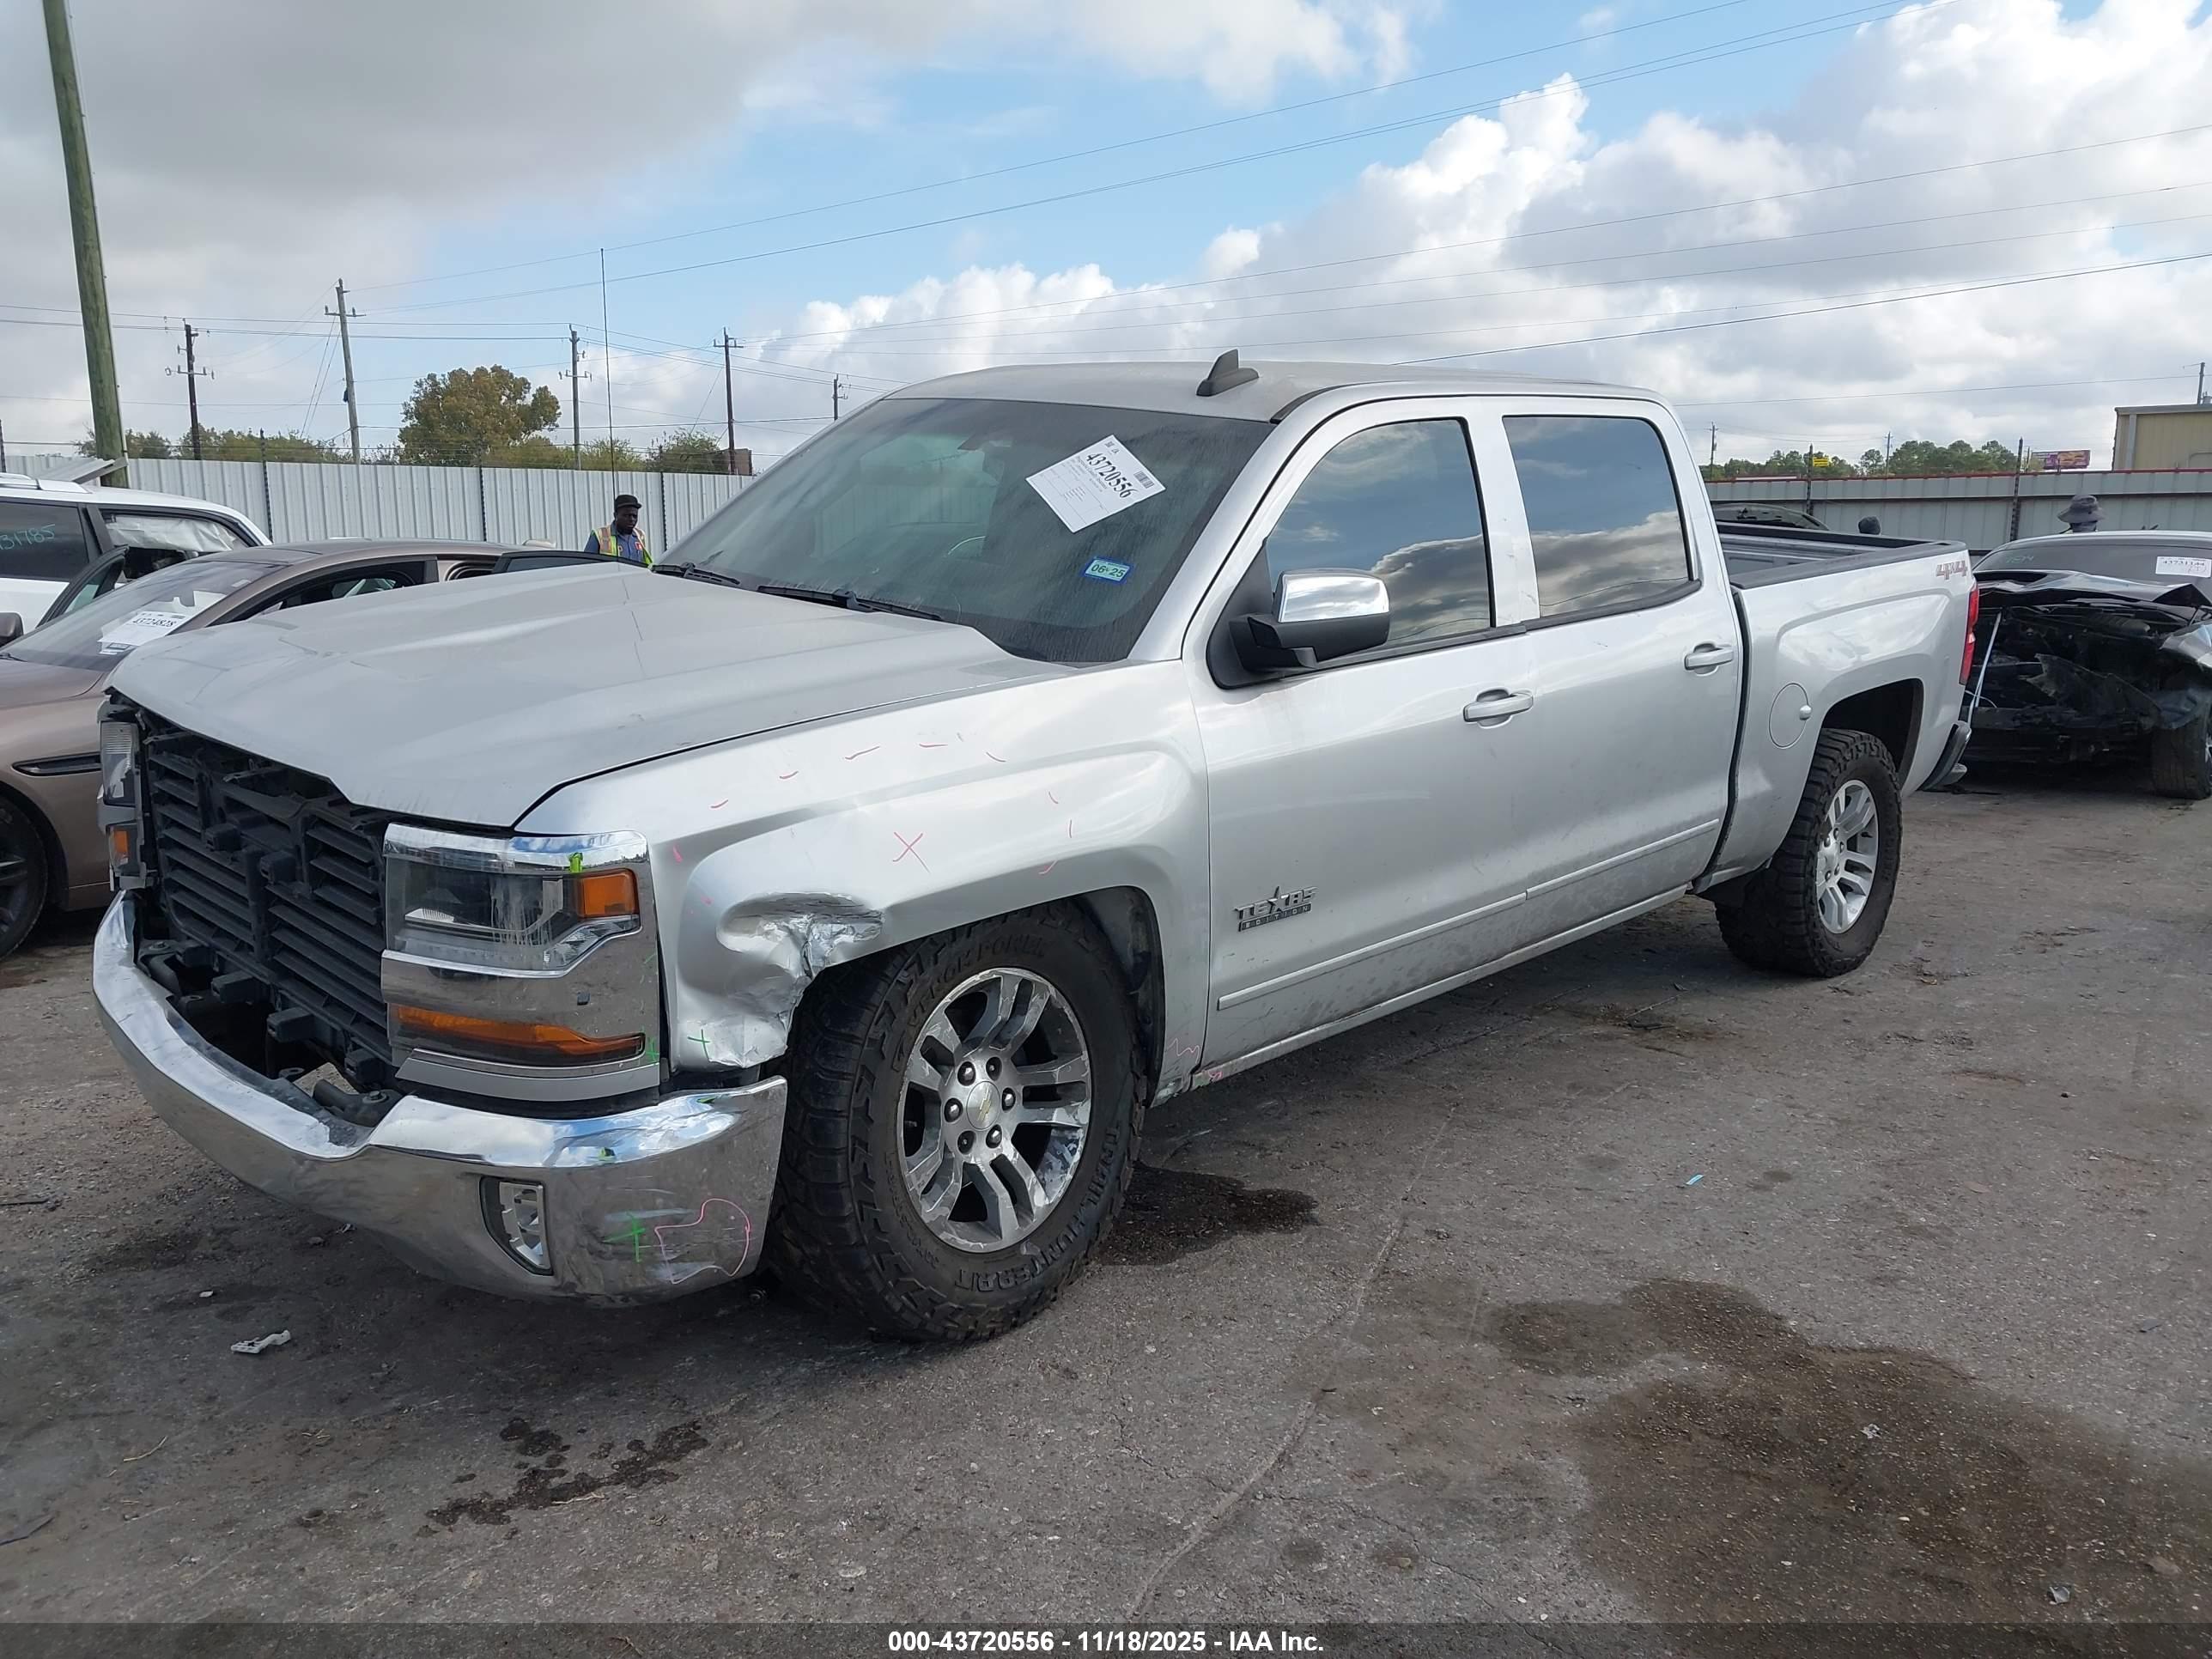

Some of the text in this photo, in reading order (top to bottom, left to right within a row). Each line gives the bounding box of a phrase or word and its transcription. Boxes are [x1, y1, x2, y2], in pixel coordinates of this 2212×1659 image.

[1085, 452, 1139, 498] 43720556
[0, 523, 56, 550] 31785
[1091, 563, 1126, 577] 06 25
[132, 617, 178, 628] 43724828
[1234, 886, 1318, 920] TEXAS
[1244, 905, 1310, 929] EDITION
